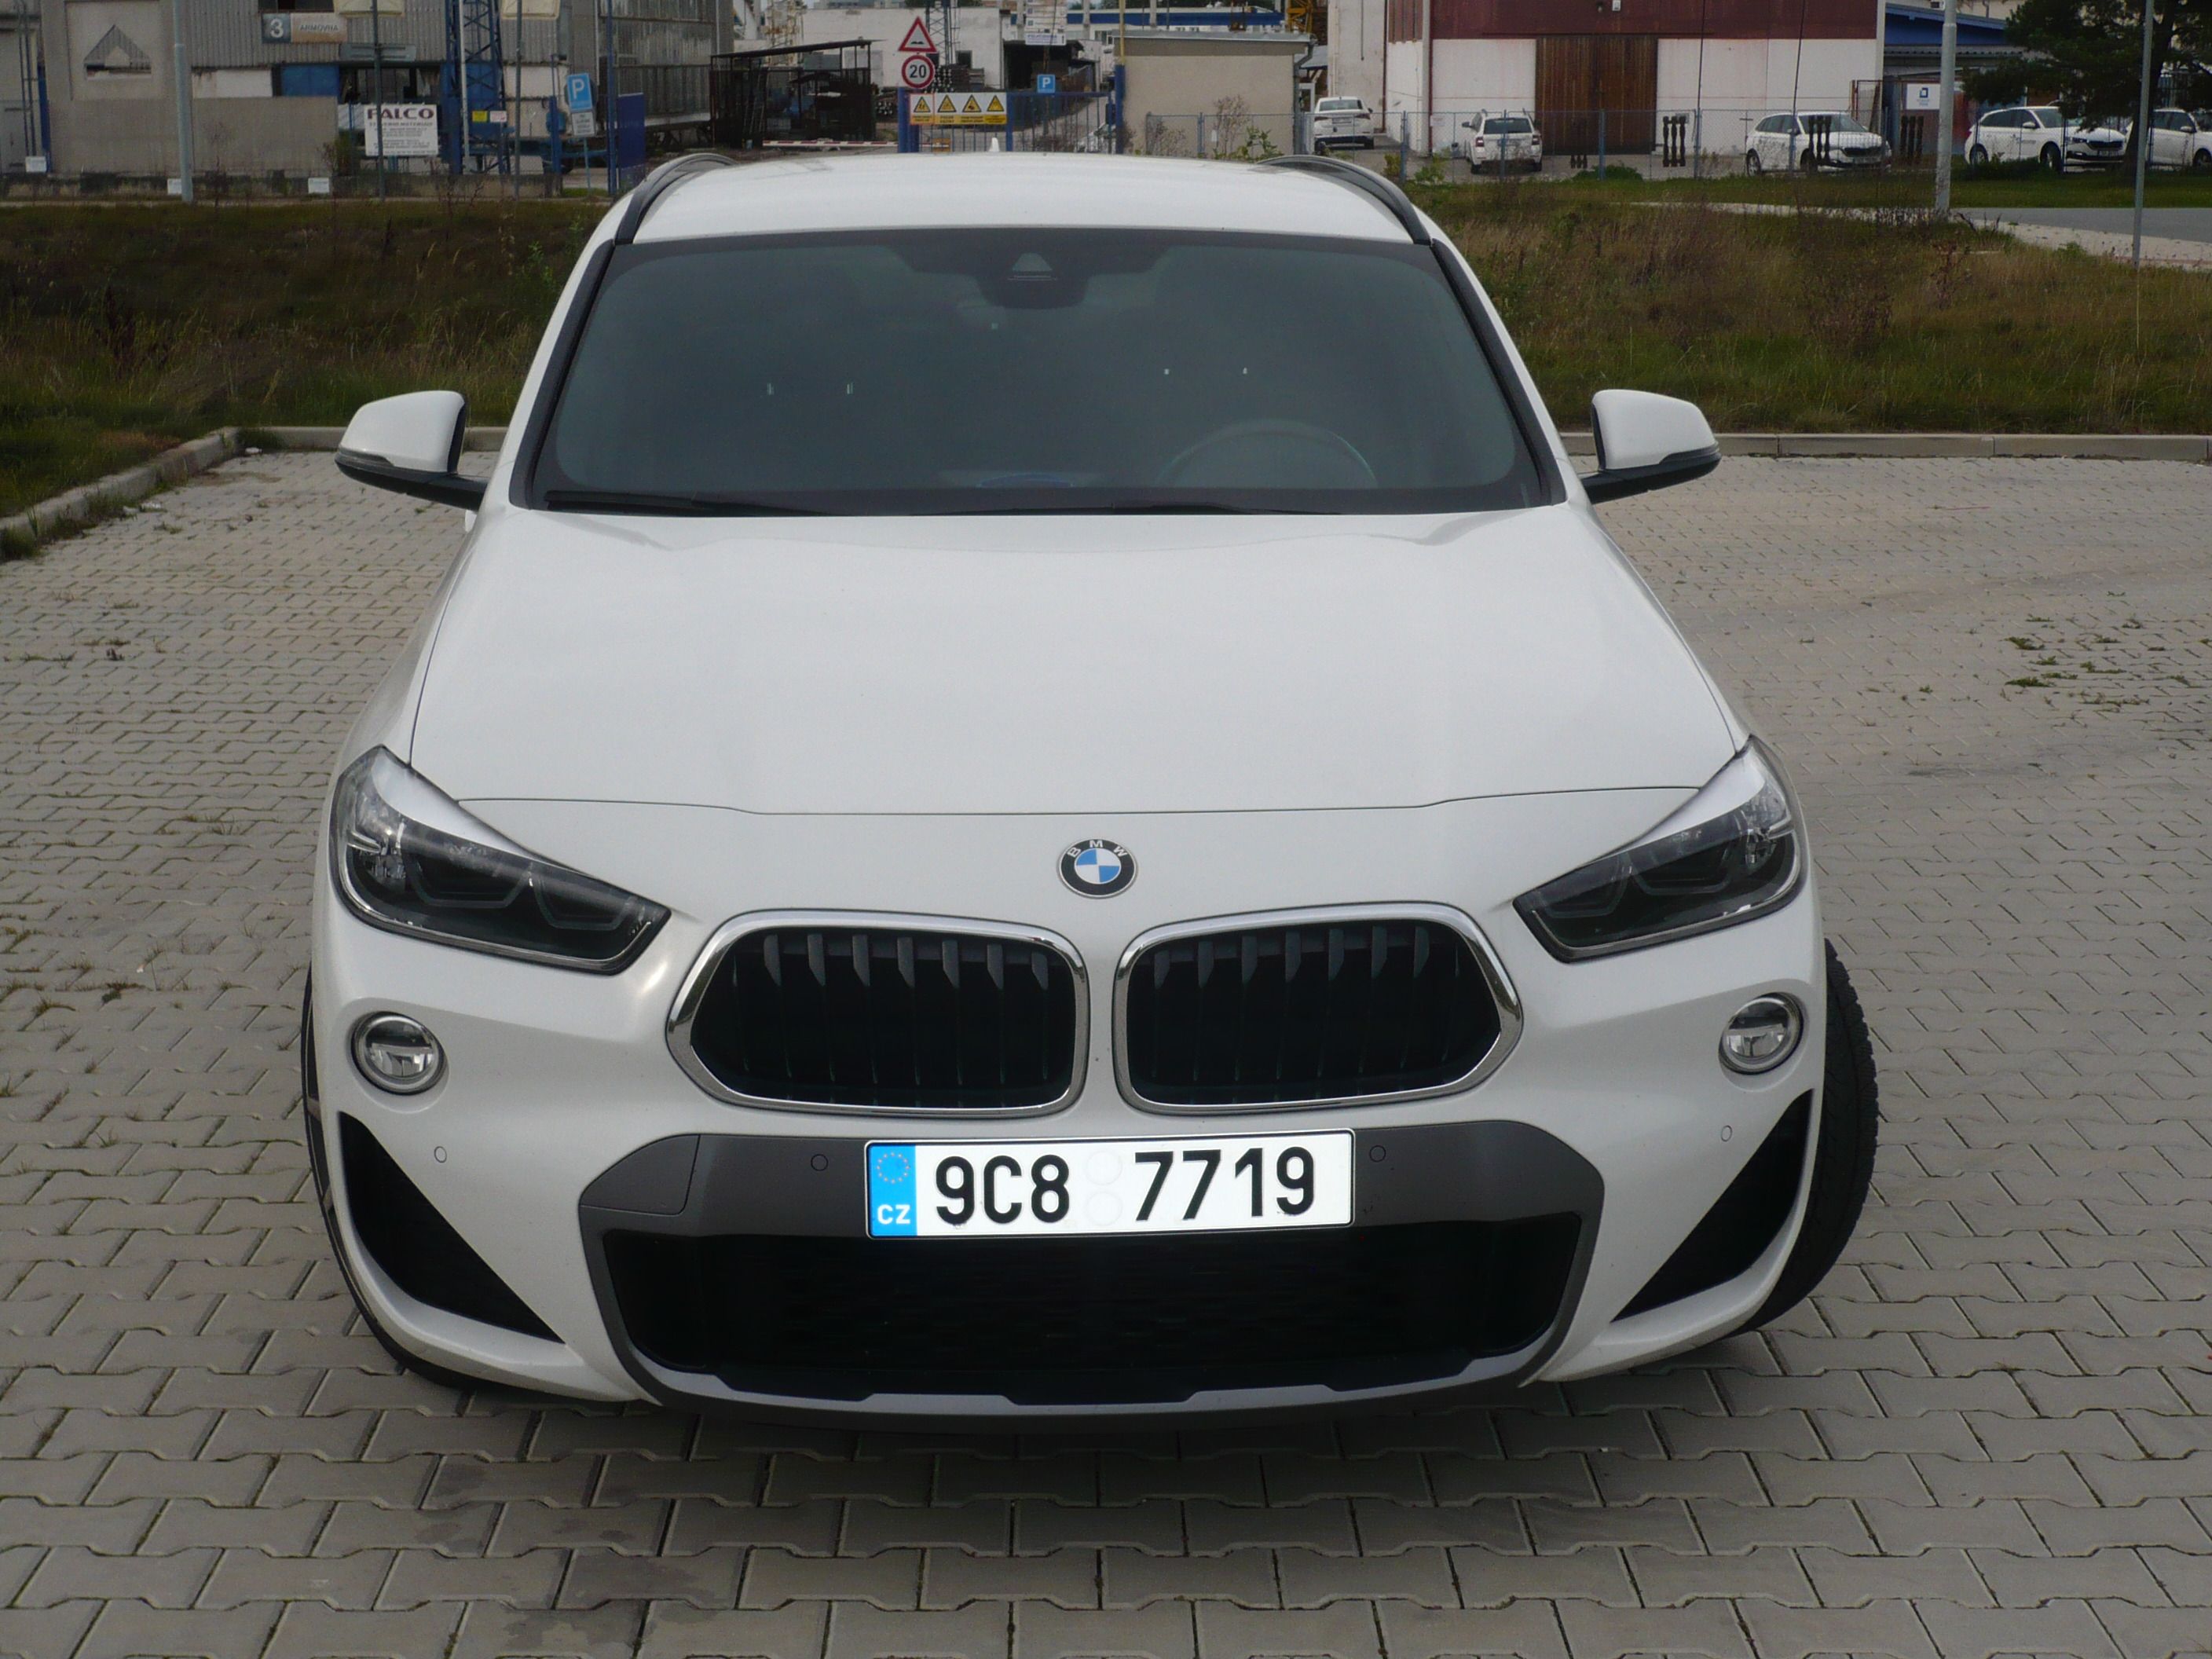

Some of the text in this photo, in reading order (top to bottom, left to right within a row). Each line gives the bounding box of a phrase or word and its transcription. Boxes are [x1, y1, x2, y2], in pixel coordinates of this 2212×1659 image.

[270, 18, 284, 38] 3
[910, 64, 927, 79] 20
[571, 79, 584, 100] P
[1042, 77, 1051, 88] P
[368, 108, 434, 119] FALCO
[1067, 840, 1128, 858] BMW
[935, 1146, 1316, 1225] 9C8 7719
[877, 1203, 911, 1225] CZ
